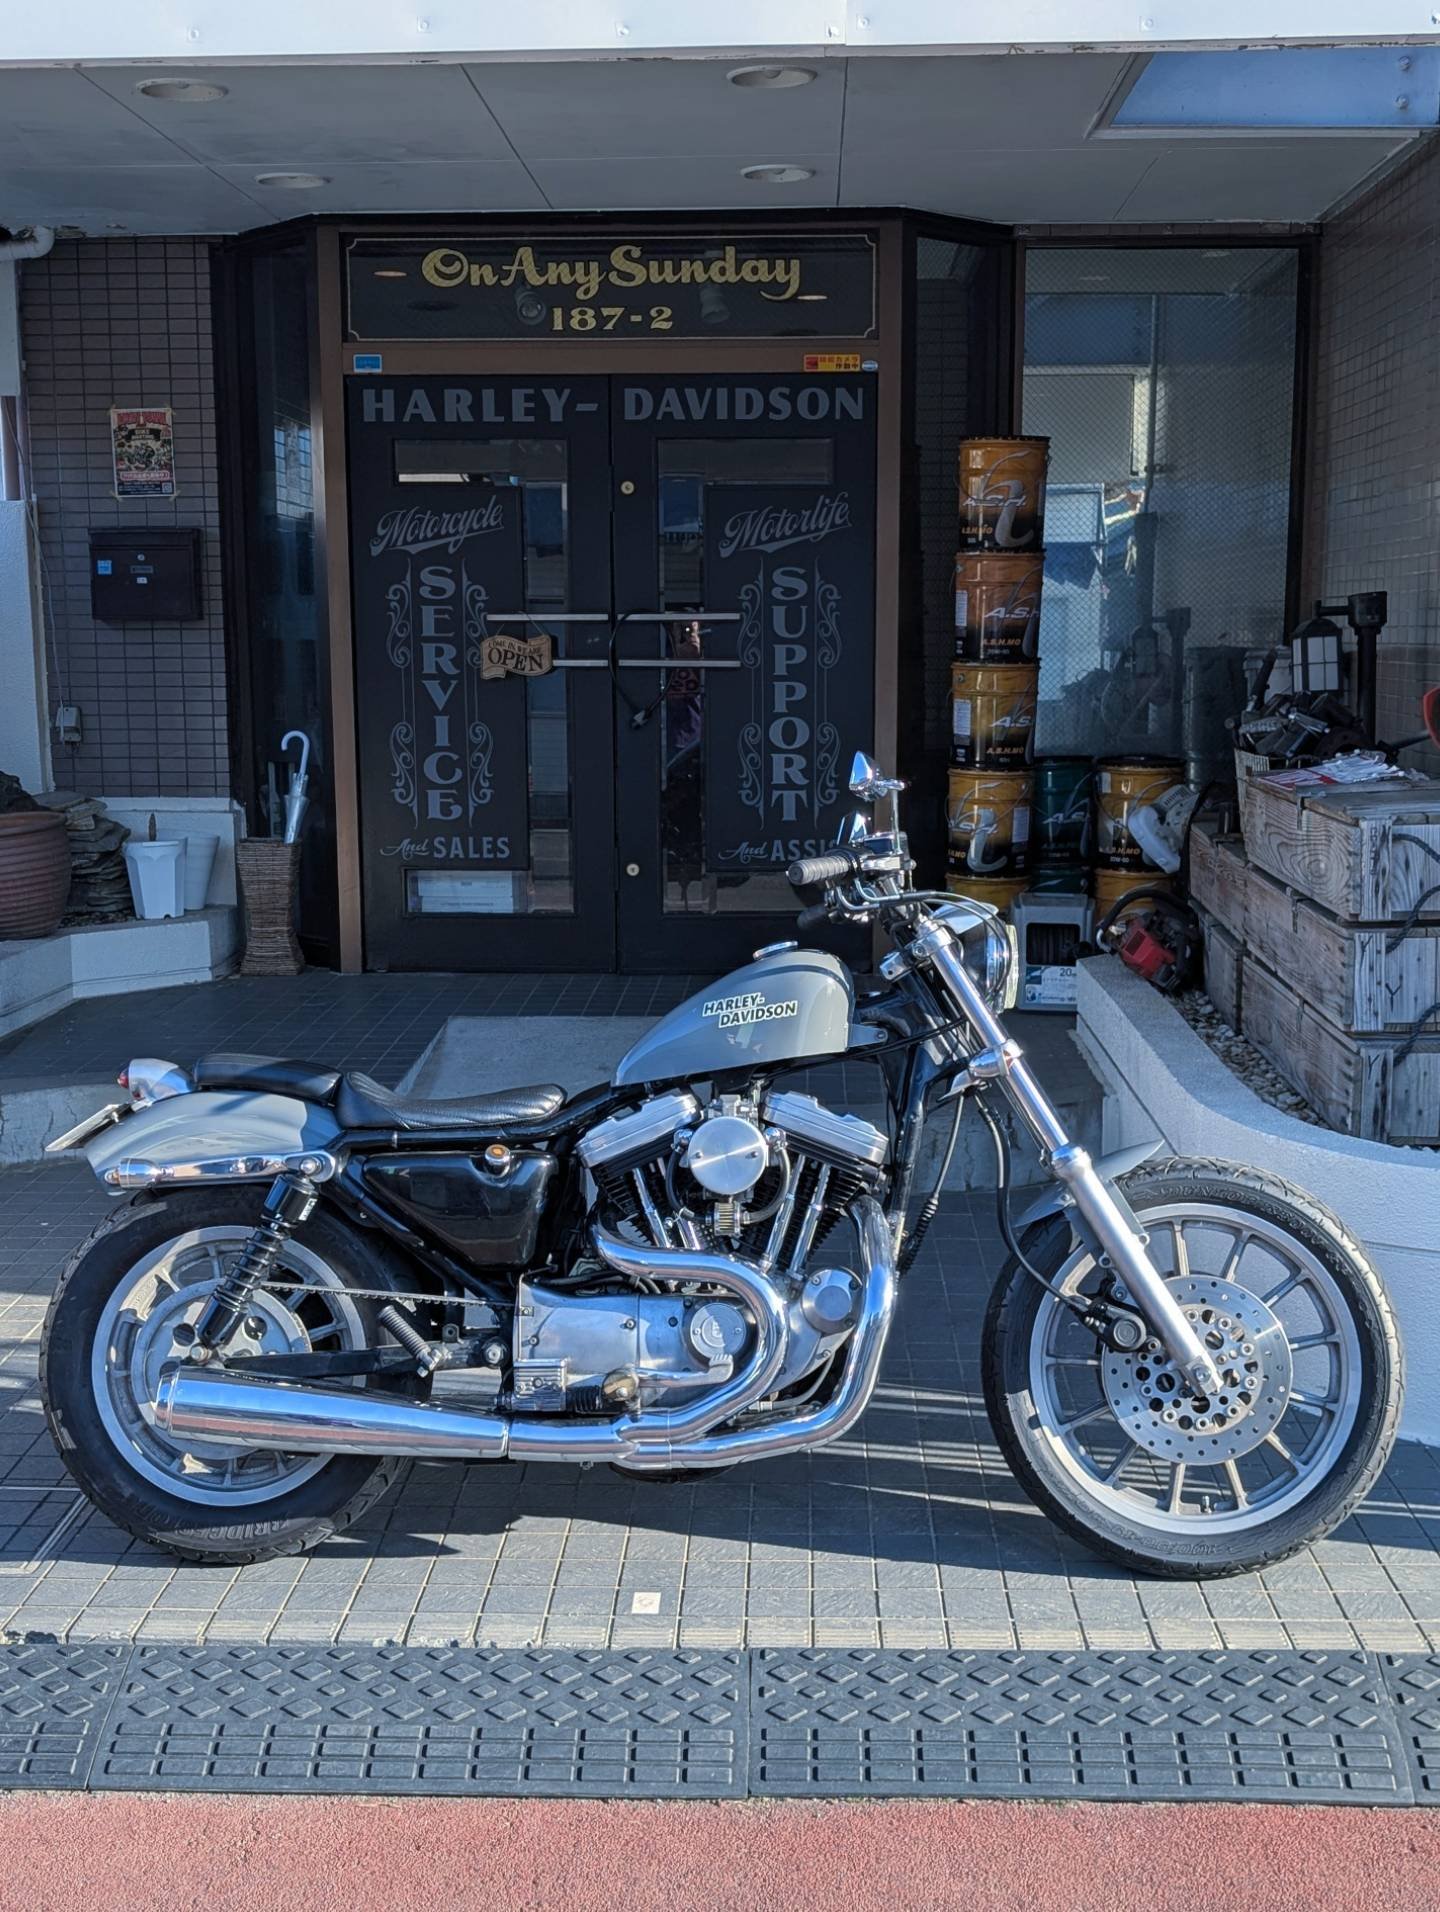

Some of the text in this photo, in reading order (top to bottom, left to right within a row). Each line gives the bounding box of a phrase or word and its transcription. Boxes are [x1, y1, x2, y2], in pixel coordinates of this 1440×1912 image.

[422, 245, 800, 301] On Any Sunday
[551, 306, 673, 332] 187-2
[362, 388, 599, 423] HARLEY-
[623, 387, 864, 422] DAVIDSON
[369, 494, 504, 557] Motorcycle
[718, 491, 852, 558] Motorlife
[487, 647, 544, 671] OPEN
[419, 566, 464, 821] SERVICE
[768, 566, 811, 822] SUPPORT
[379, 836, 511, 862] And SALES
[718, 839, 836, 864] And ASSI
[703, 992, 765, 1017] HARLEY-
[719, 1000, 798, 1028] DAVIDSON
